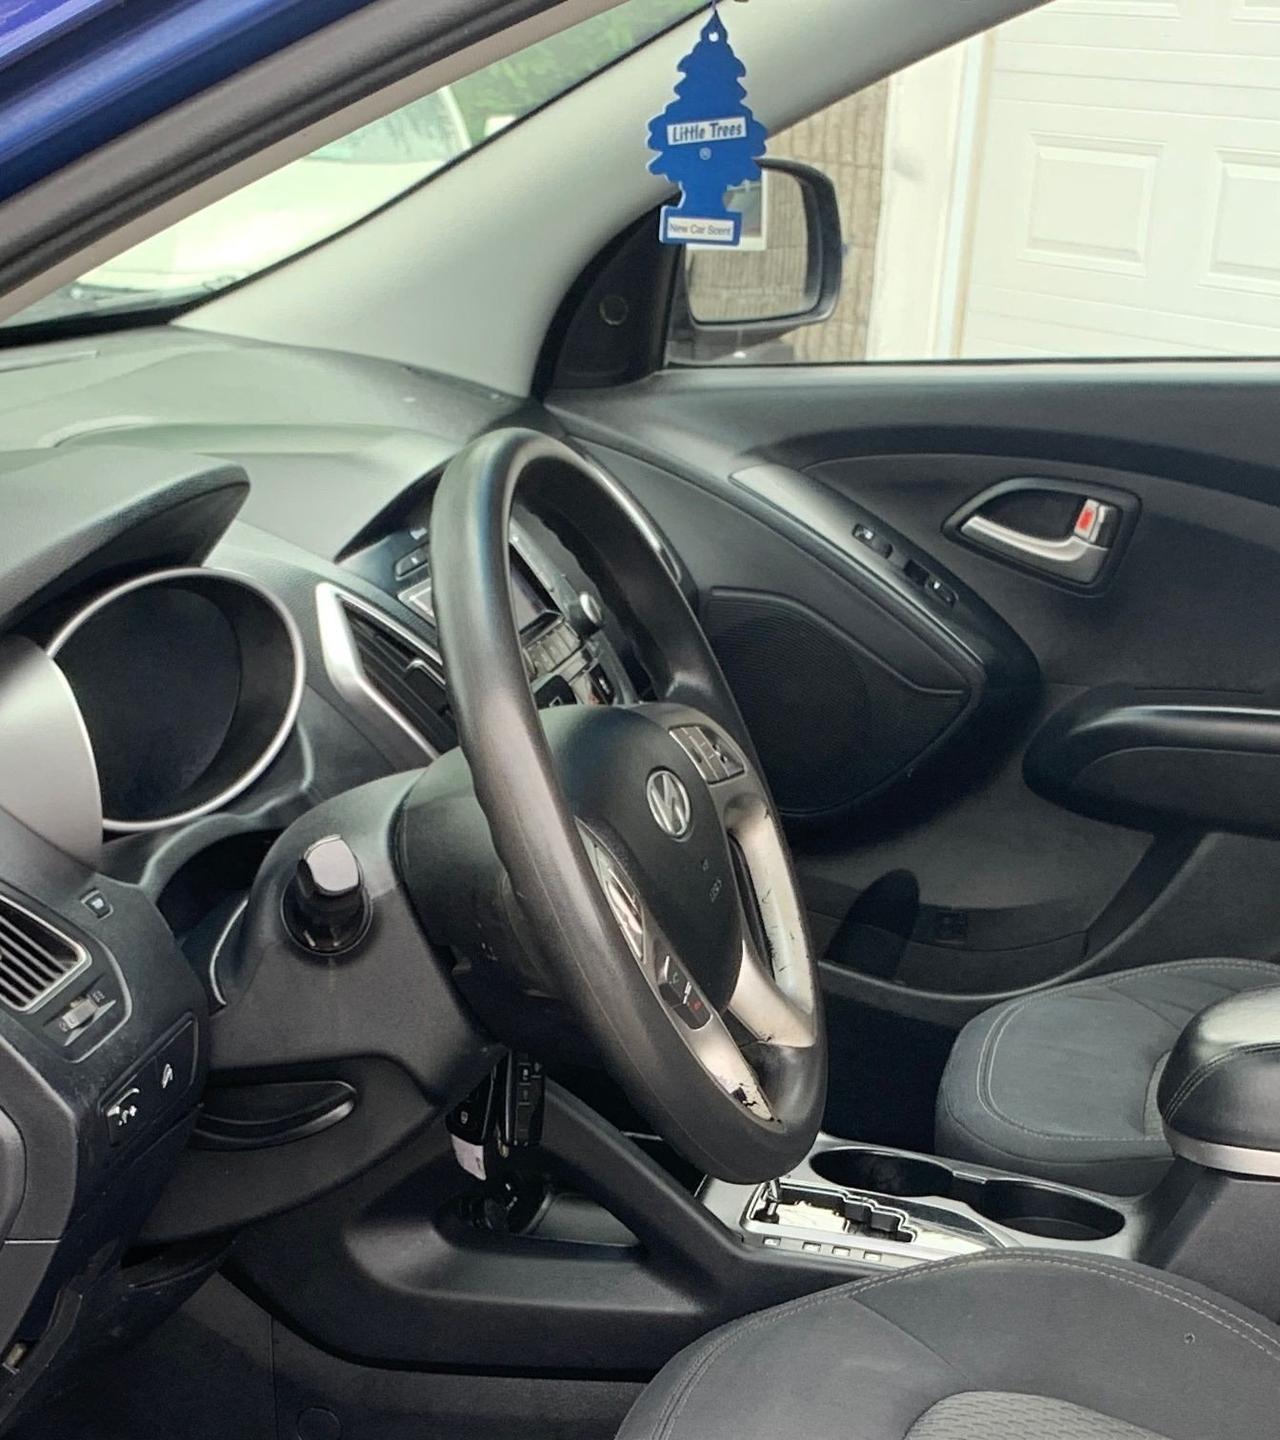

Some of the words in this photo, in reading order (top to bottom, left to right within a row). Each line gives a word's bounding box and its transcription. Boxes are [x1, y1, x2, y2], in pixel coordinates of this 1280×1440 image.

[673, 125, 705, 143] Little
[710, 122, 743, 138] Trees
[670, 222, 688, 234] New
[690, 224, 705, 235] Car
[707, 225, 732, 236] Scent
